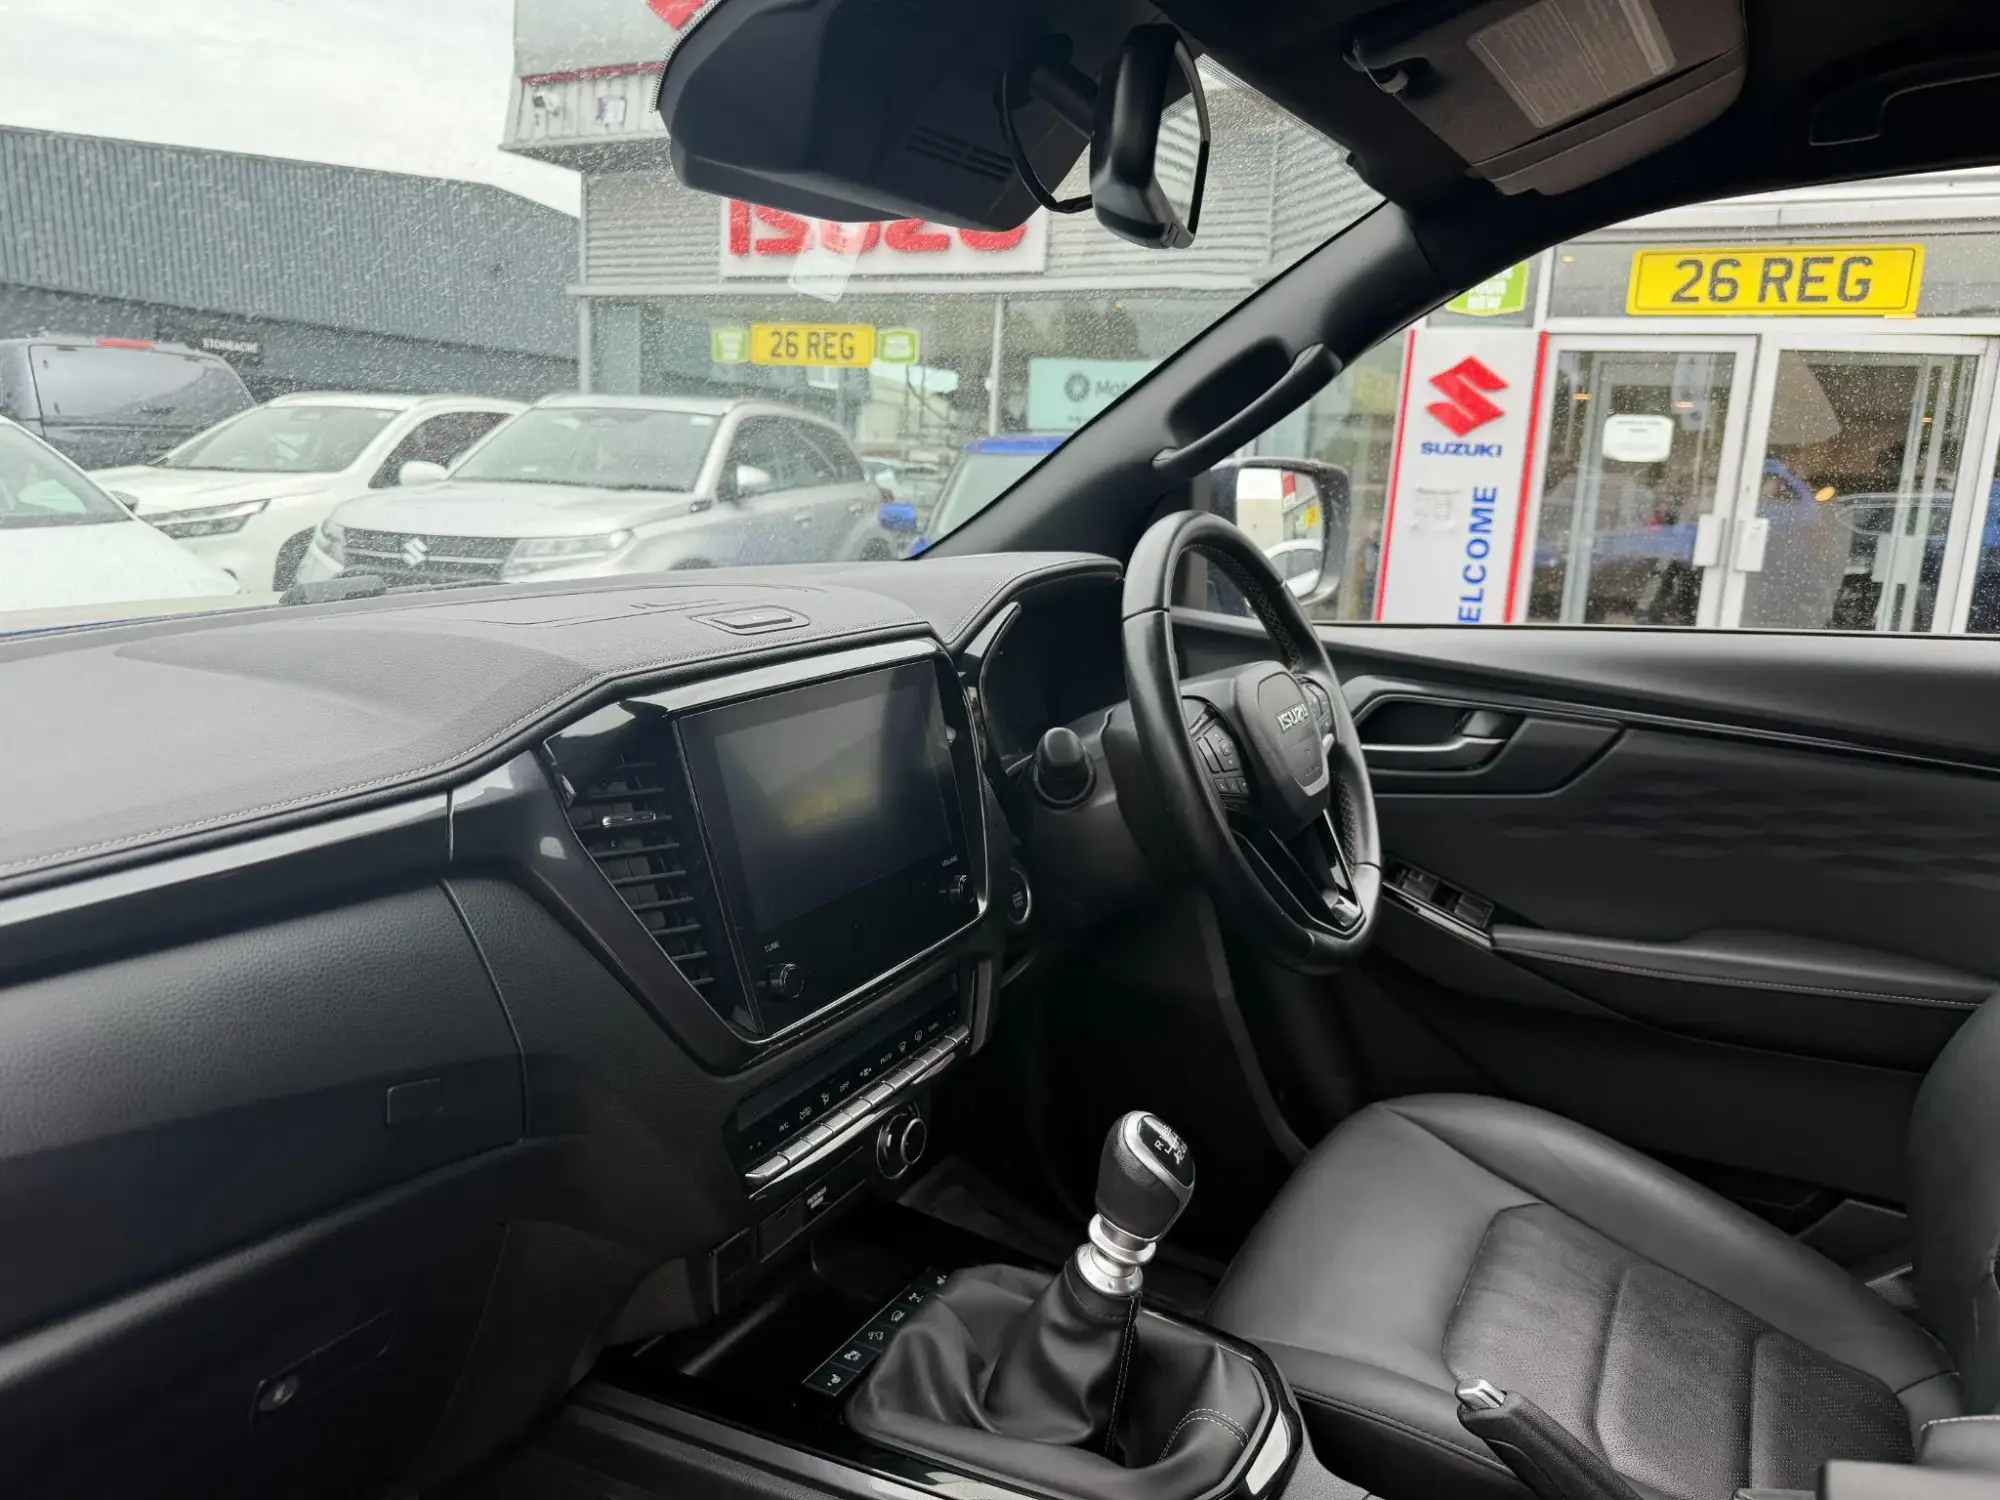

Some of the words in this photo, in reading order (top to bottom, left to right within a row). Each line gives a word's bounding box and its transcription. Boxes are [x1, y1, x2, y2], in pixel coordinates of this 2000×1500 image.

[1670, 257, 1741, 303] 26
[1757, 256, 1874, 303] REG
[769, 331, 800, 359] 26
[806, 332, 856, 361] REG
[1420, 442, 1503, 458] SUZUKI
[1456, 485, 1498, 623] ELCOME
[1276, 703, 1309, 731] ISUZU
[1154, 1139, 1164, 1151] R
